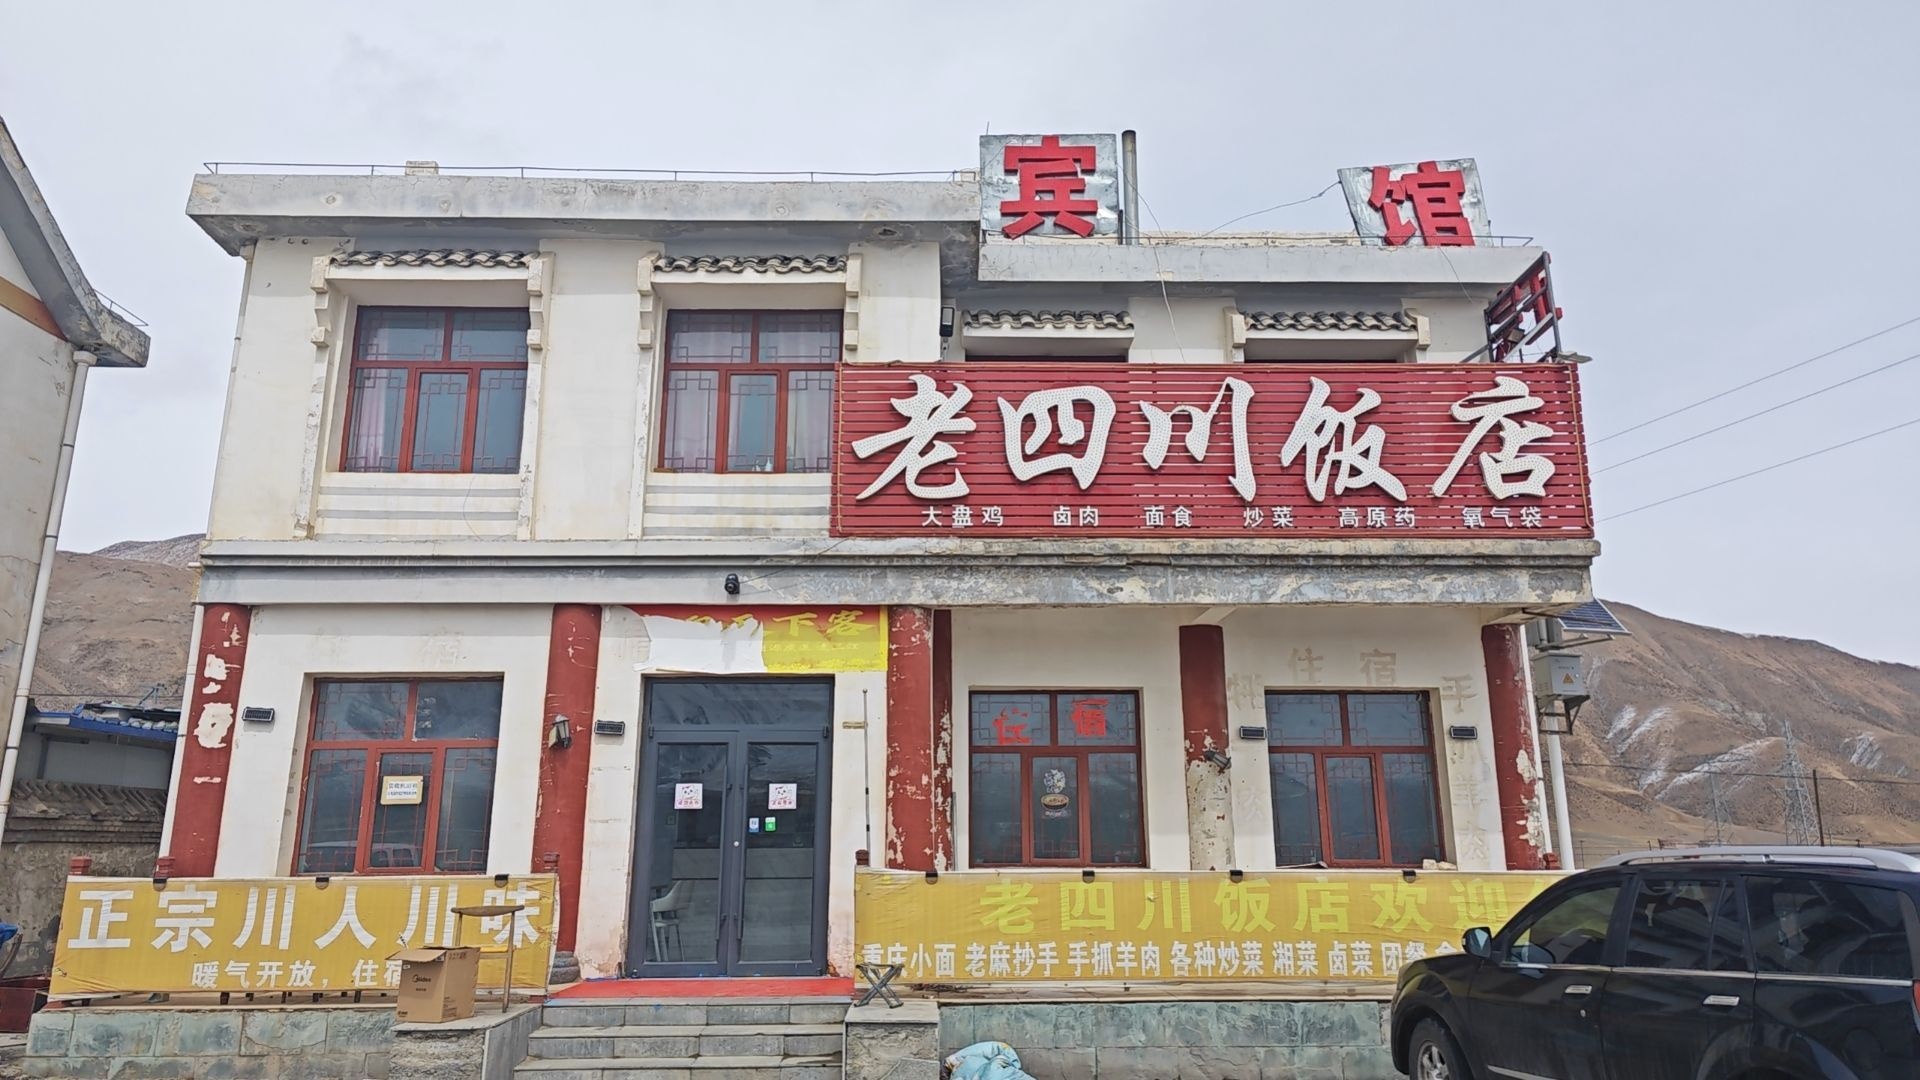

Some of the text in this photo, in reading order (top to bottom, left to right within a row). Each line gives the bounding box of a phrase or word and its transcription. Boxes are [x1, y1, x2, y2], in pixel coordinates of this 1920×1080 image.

[851, 374, 1555, 502] 老四川饭店
[921, 505, 1543, 528] 大盘鸡 卤肉 面食 炒菜 高原药 氧气袋
[67, 883, 544, 952] 正宗川人川味
[965, 941, 1059, 977] 老麻抄手
[1067, 941, 1160, 977] 手抓羊肉
[1170, 940, 1264, 977] 各种炒菜
[1272, 941, 1318, 977] 湘菜
[1328, 941, 1373, 977] 卤菜
